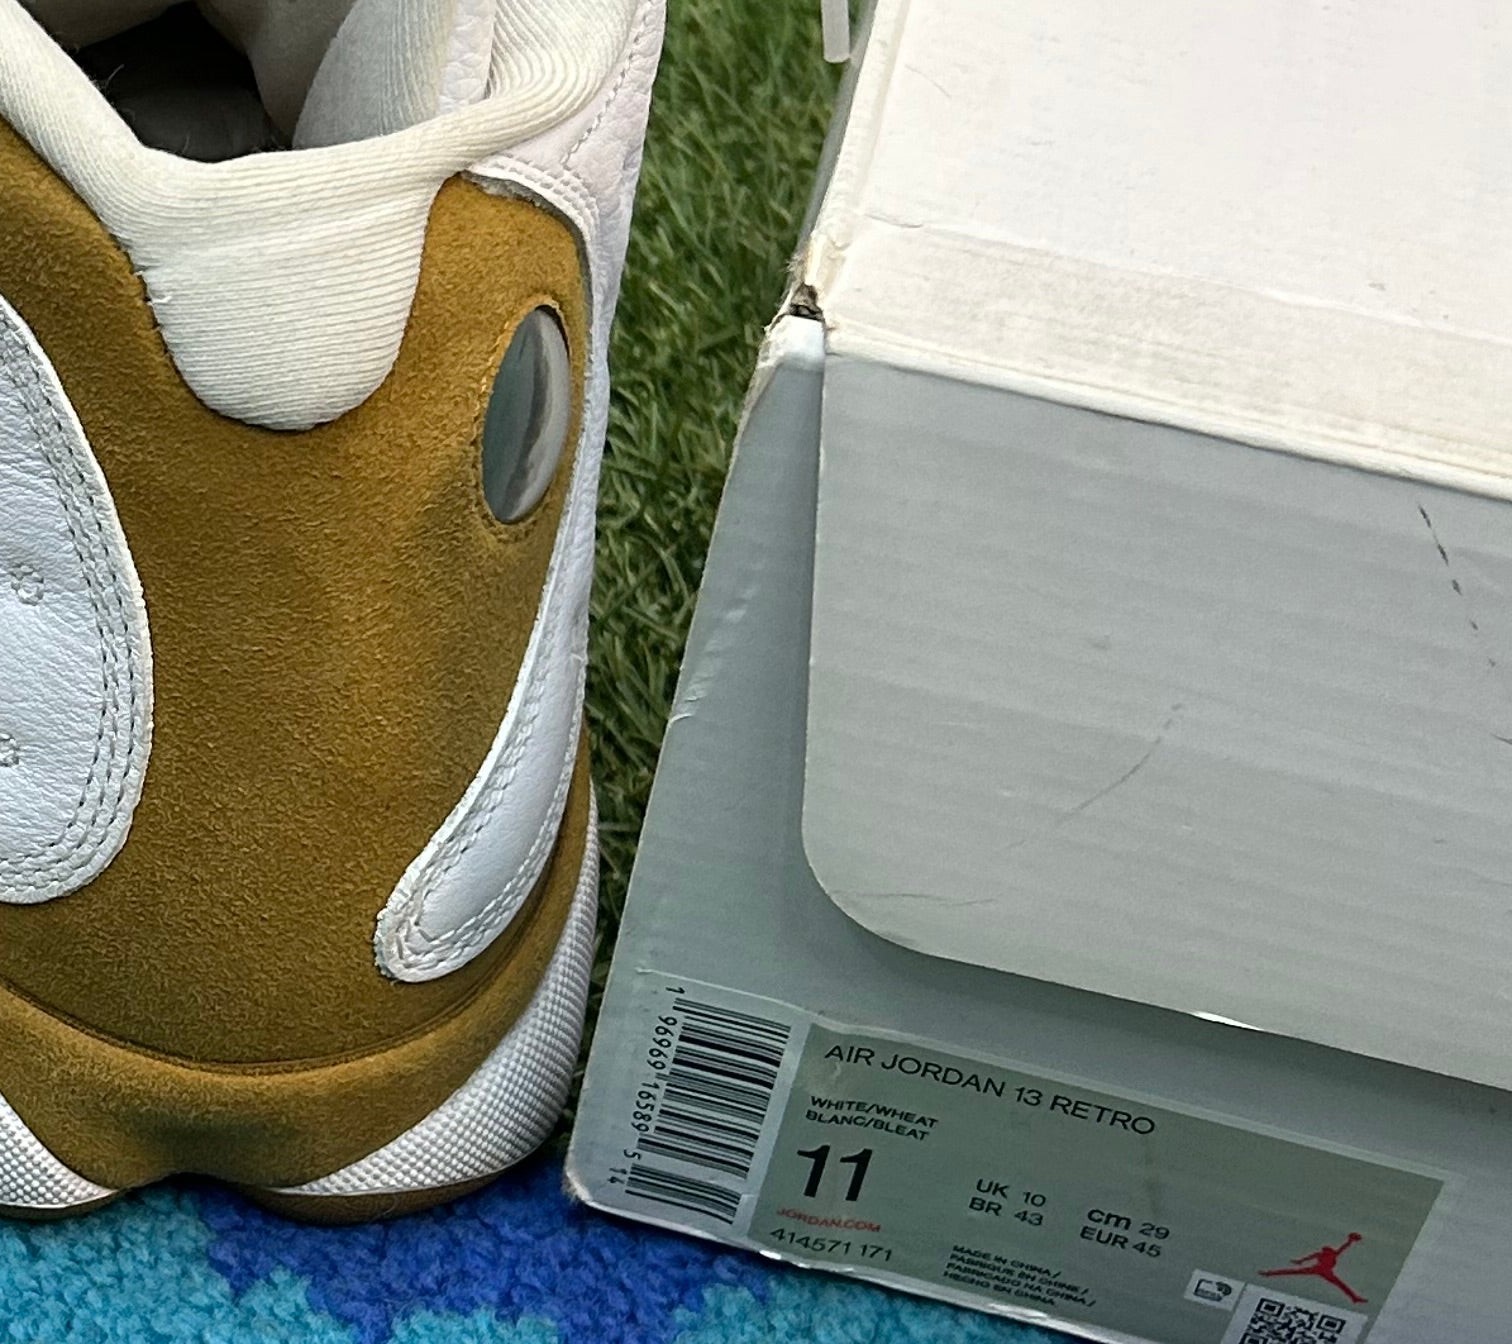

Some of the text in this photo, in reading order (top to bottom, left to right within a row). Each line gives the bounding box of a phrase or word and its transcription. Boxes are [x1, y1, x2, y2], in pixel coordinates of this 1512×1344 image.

[623, 986, 685, 1160] 1 96969 16589 5
[824, 1045, 1155, 1135] AIR JORDAN 13 RETRO
[806, 1109, 931, 1141] BLANC/BLEAT
[811, 1096, 939, 1128] WHITE/WHEAT
[797, 1144, 873, 1202] 11
[976, 1178, 1046, 1207] UK 10
[776, 1208, 881, 1232] JORDAN.COM
[969, 1196, 1044, 1226] BR 43
[1088, 1209, 1170, 1240] cm 29
[770, 1228, 893, 1262] 414571 171
[953, 1245, 991, 1259] MADE
[994, 1255, 1007, 1265] IN
[1080, 1226, 1162, 1258] EUR 45
